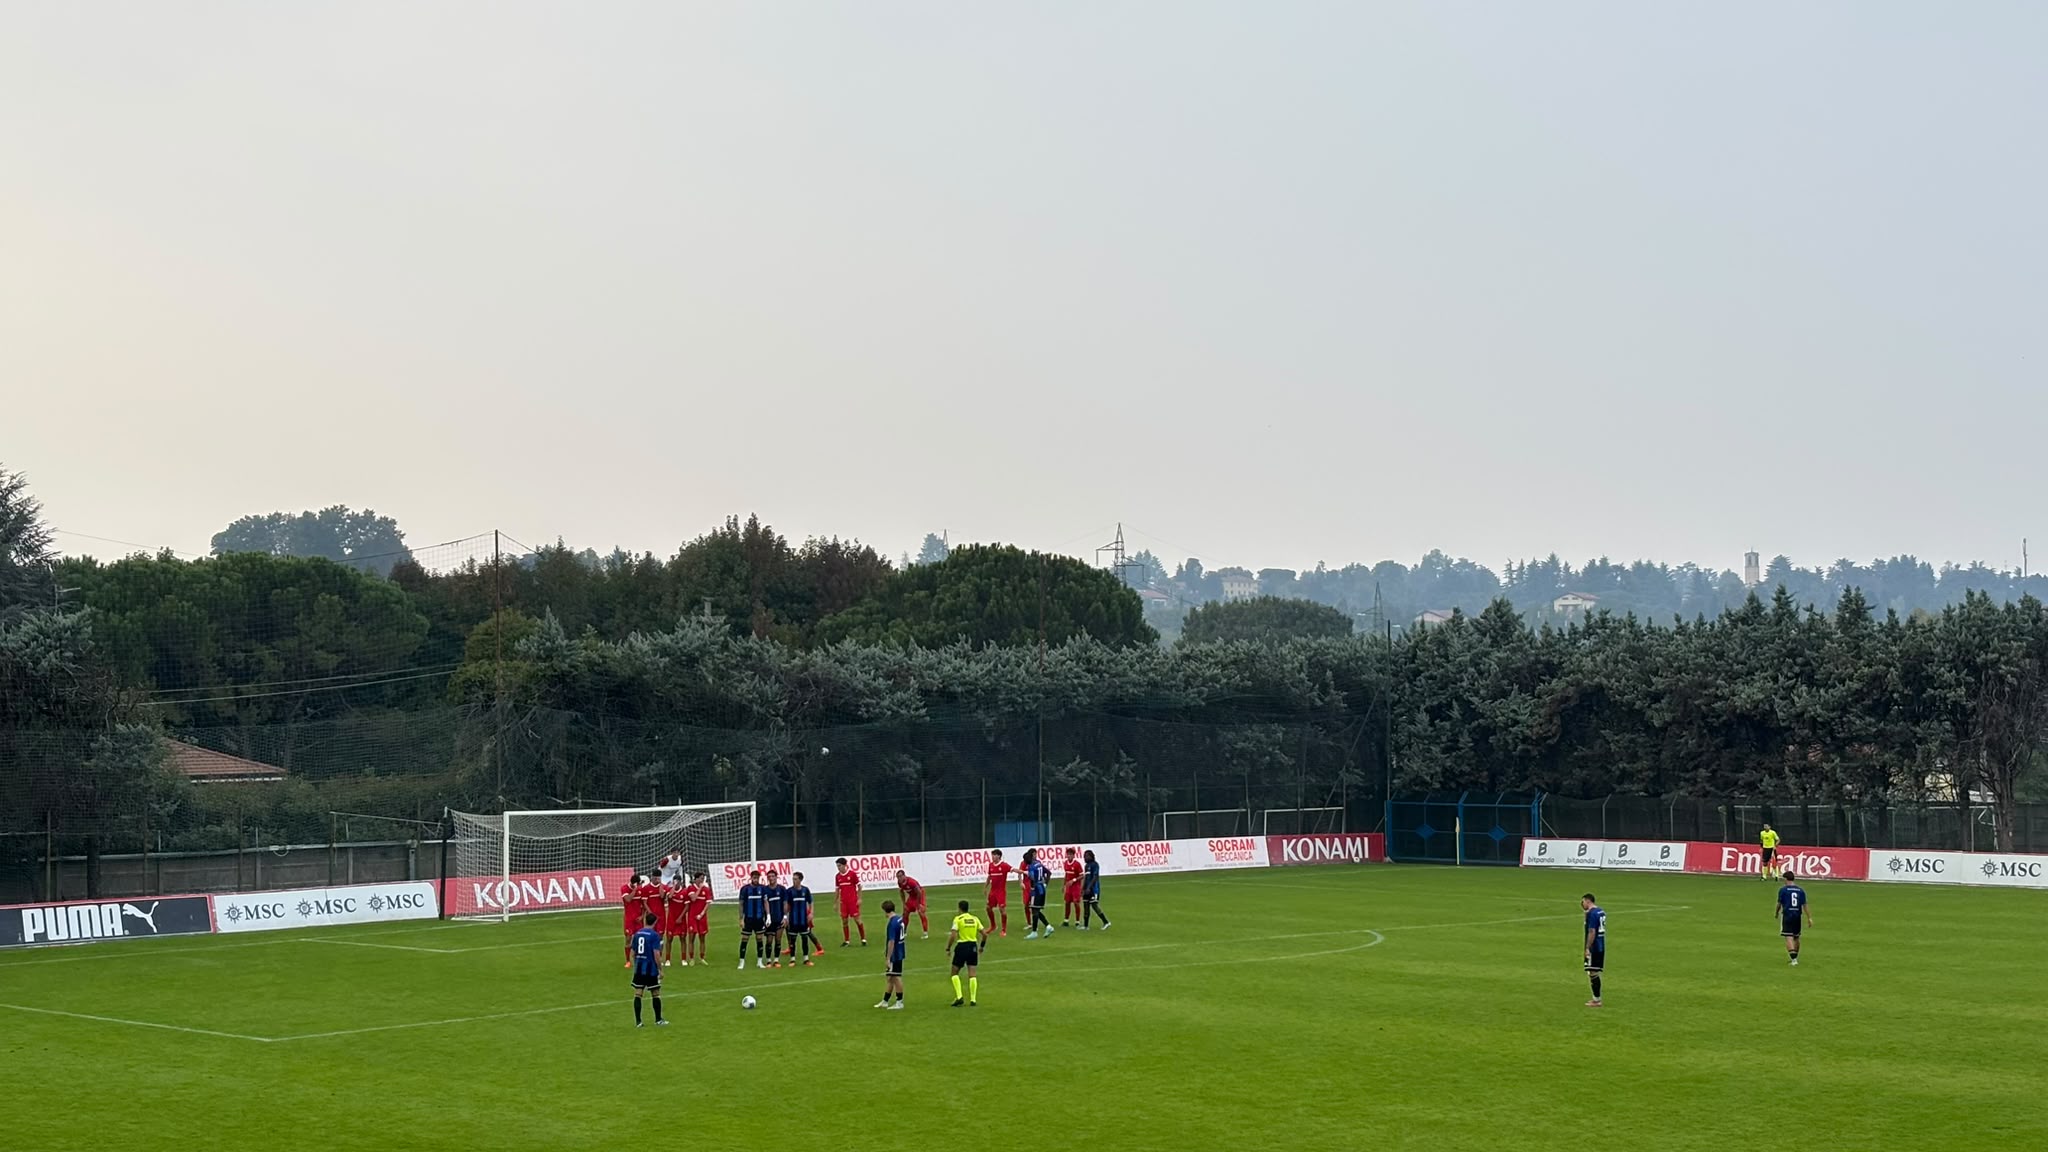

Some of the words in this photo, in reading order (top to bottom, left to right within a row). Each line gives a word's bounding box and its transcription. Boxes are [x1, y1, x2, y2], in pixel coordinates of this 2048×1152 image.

[1121, 842, 1171, 857] SOCRAM
[1208, 838, 1255, 852] SOCRAM
[1282, 836, 1369, 862] KONAMI
[849, 855, 901, 871] OCRAM
[946, 851, 991, 866] SOCRA
[1527, 856, 1555, 864] bitpanda
[1905, 858, 1945, 873] MSC
[1999, 862, 2042, 877] MSC
[473, 875, 606, 908] KONAMI
[1791, 892, 1798, 907] 6
[314, 898, 357, 915] MSC
[385, 893, 425, 910] MSC
[244, 903, 286, 920] MSC
[22, 903, 124, 943] PUMA
[637, 936, 645, 954] 8
